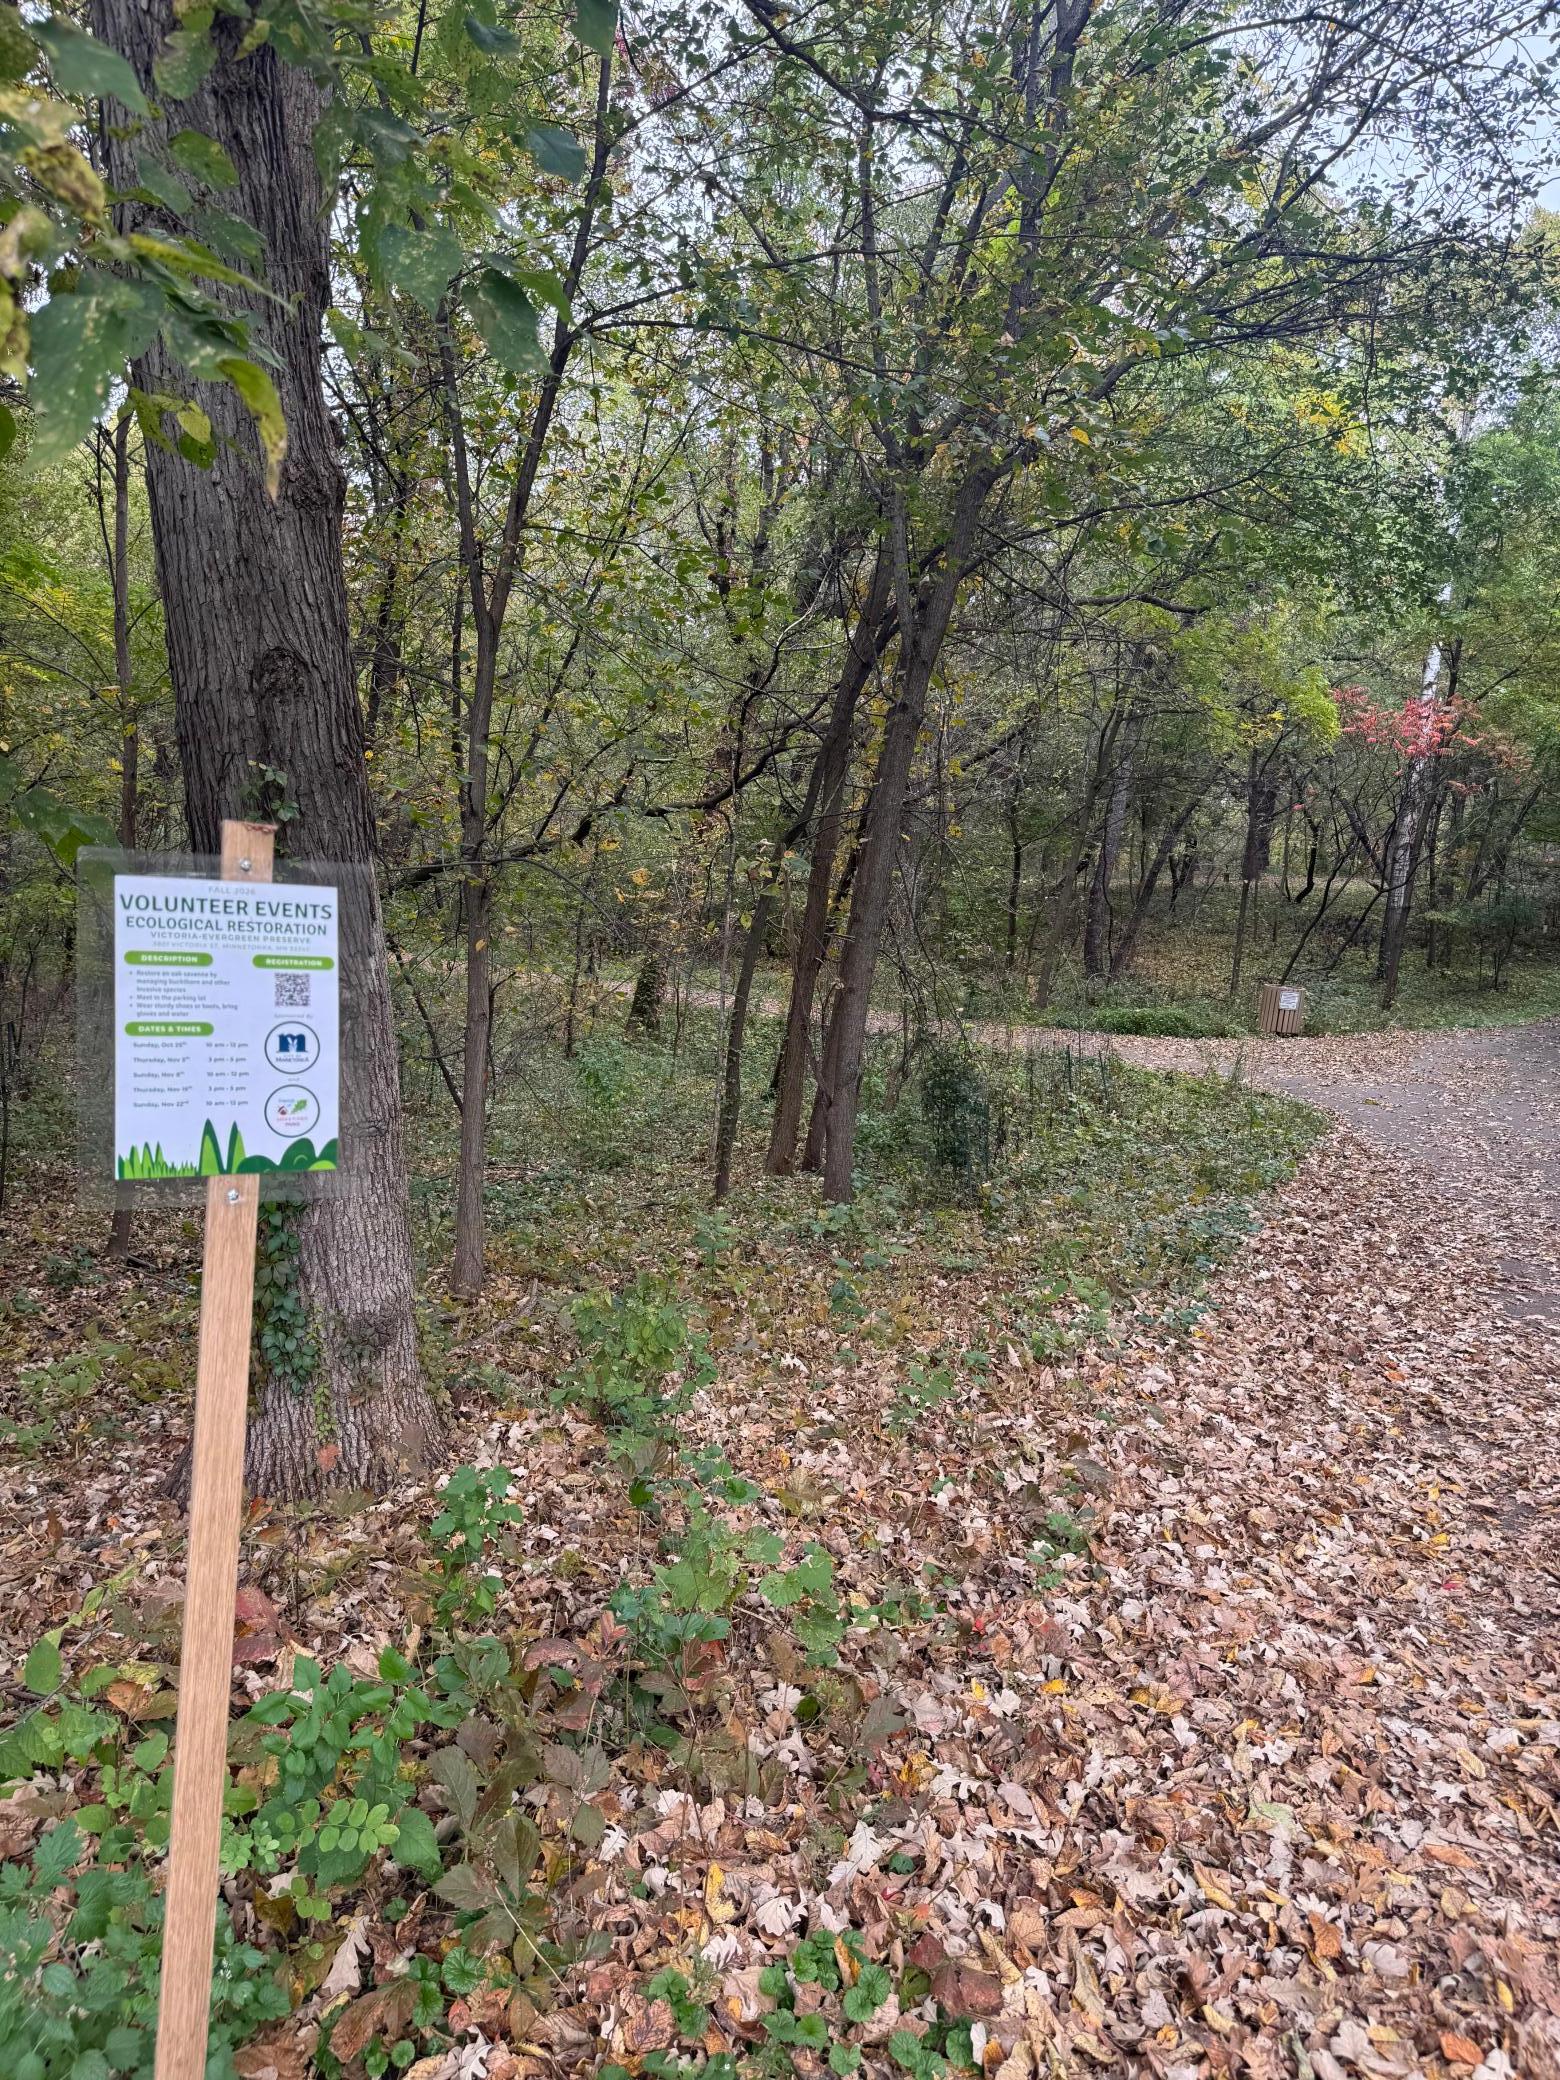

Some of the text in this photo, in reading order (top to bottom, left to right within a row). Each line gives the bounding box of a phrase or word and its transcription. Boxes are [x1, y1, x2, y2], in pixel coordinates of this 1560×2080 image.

[120, 894, 332, 920] VOLUNTEER EVENTS
[126, 916, 327, 936] ECOLOGICAL RESTORATION
[150, 931, 311, 945] VICTORIA-EVERGREEN PRESERVE
[141, 954, 198, 963] DESCRIPTION
[265, 958, 323, 967] REGISTRATION
[138, 1025, 166, 1033] DATES
[176, 1025, 202, 1033] TIMES
